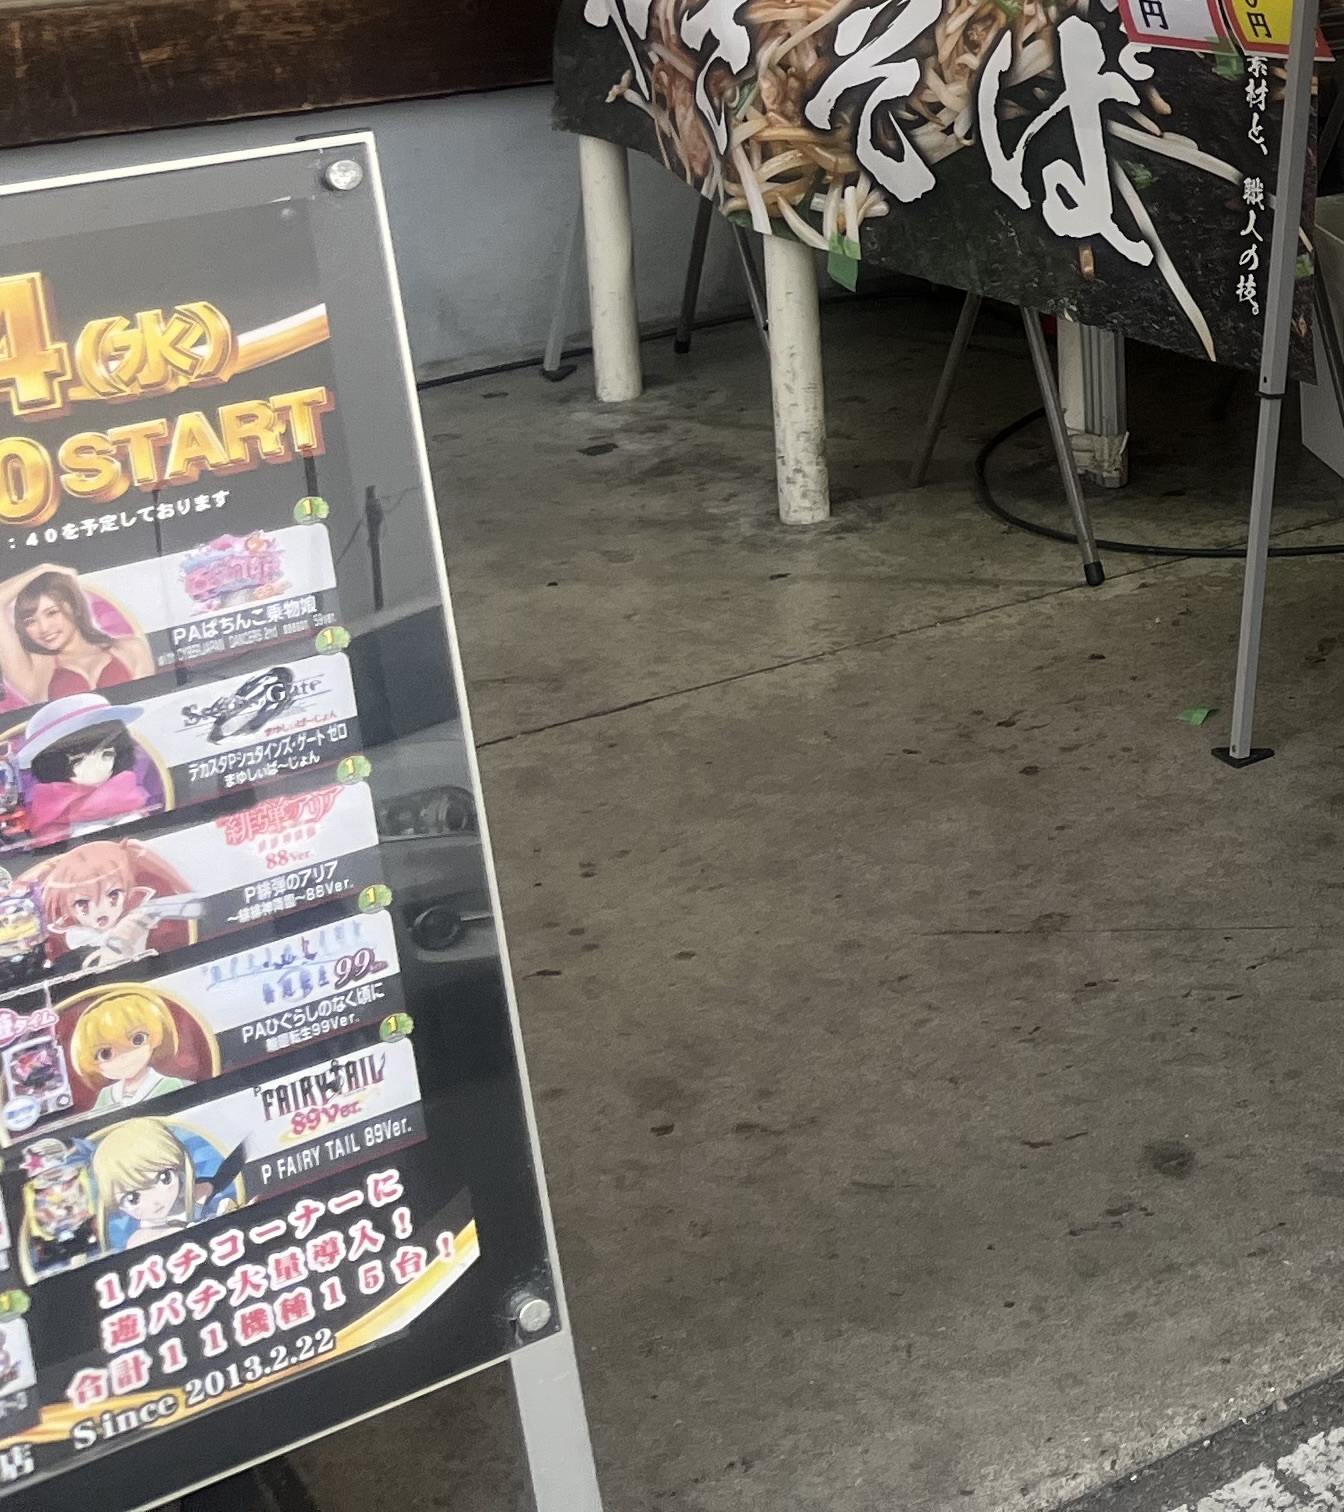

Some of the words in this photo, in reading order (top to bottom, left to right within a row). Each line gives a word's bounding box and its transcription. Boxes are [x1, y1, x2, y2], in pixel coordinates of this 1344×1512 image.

[60, 386, 334, 500] START
[261, 1163, 273, 1185] P
[276, 1147, 320, 1180] FAIRY
[325, 1134, 361, 1160] TAIL
[364, 1117, 412, 1147] 89Ver.
[70, 1390, 178, 1451] Since
[185, 1327, 337, 1406] 2013.2.22
